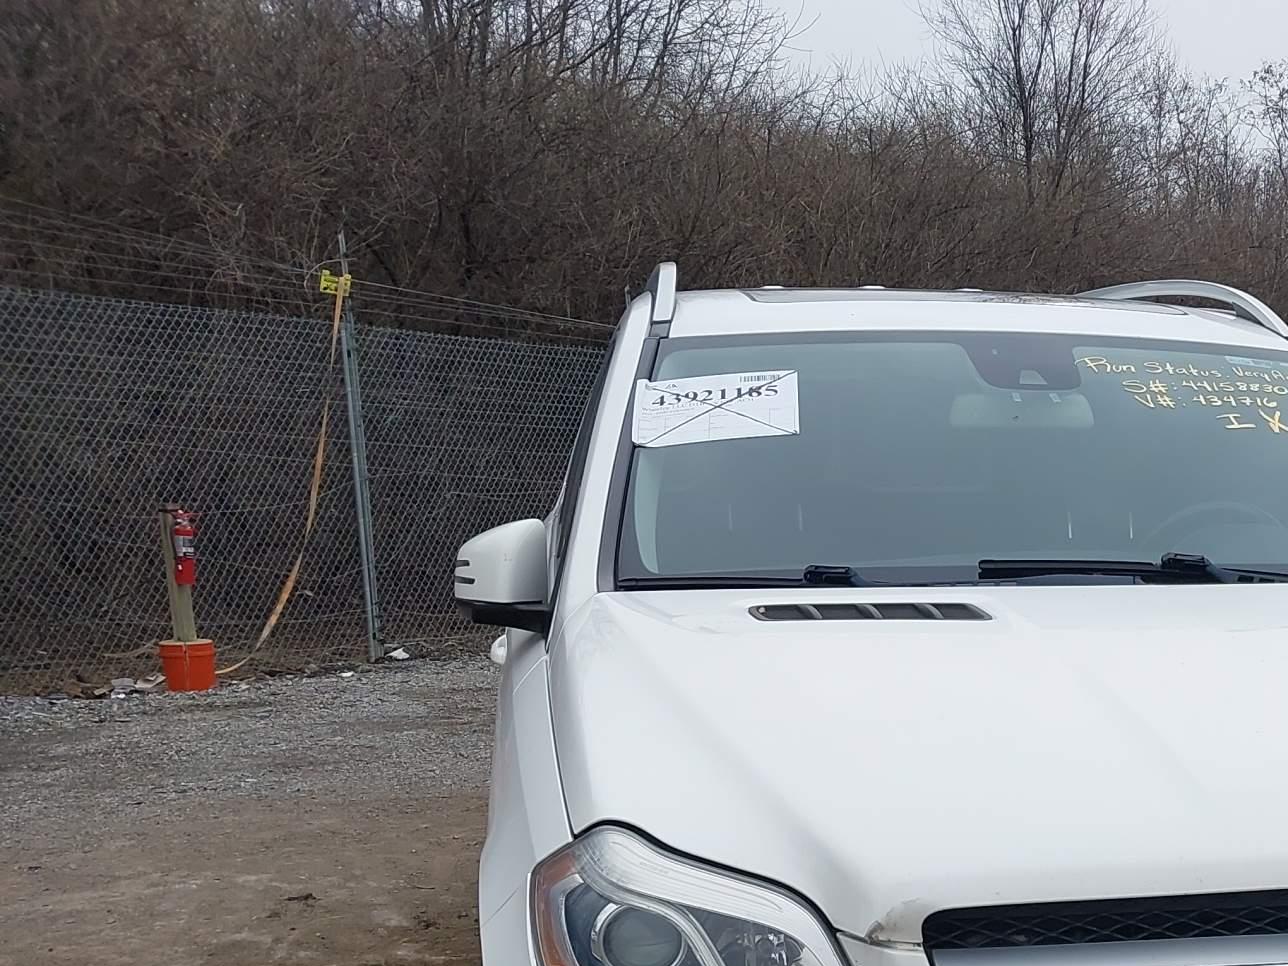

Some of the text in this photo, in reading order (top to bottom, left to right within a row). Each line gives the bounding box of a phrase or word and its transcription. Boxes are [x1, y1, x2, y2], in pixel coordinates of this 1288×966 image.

[1075, 356, 1136, 374] Run
[1182, 379, 1288, 395] 44158830
[1193, 394, 1278, 408] 434716
